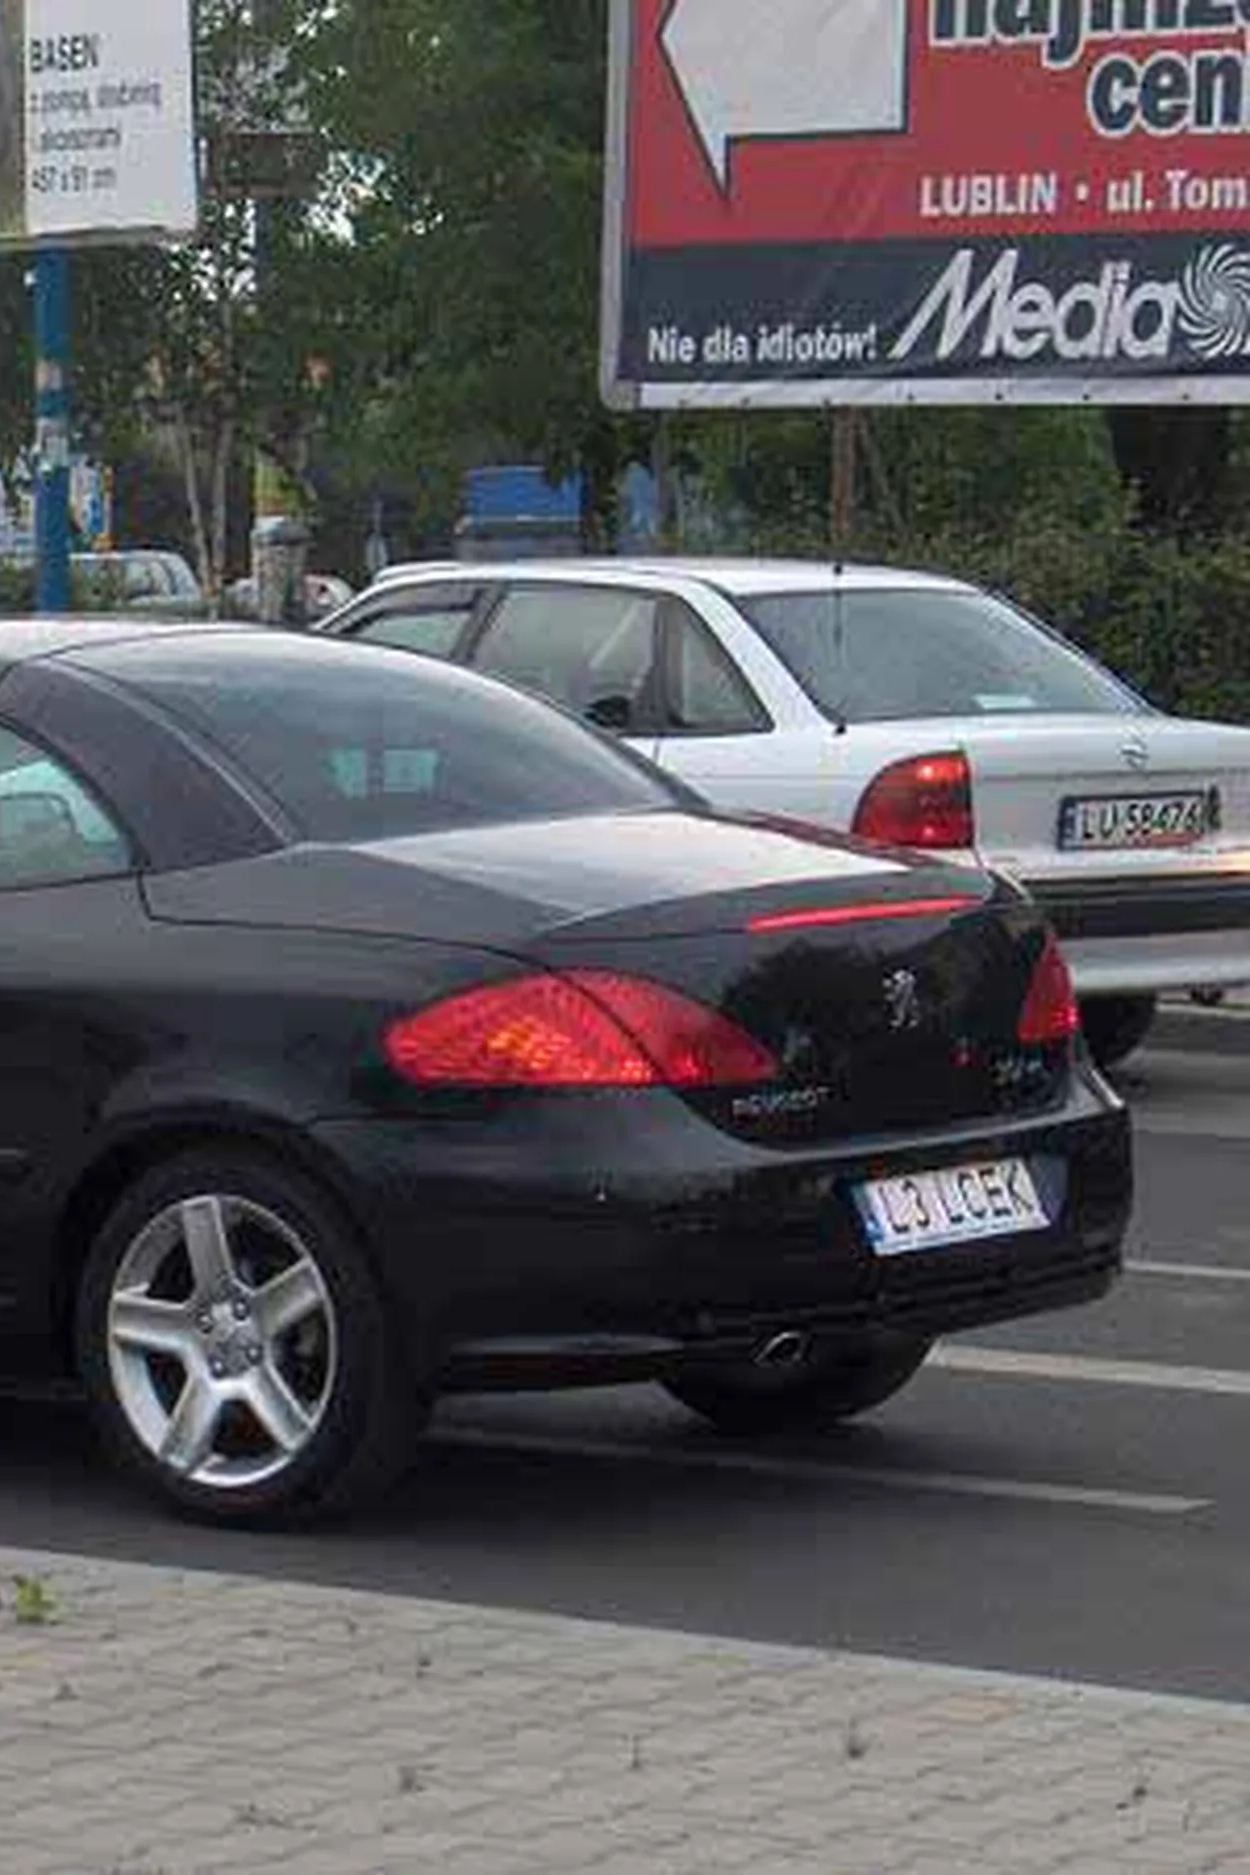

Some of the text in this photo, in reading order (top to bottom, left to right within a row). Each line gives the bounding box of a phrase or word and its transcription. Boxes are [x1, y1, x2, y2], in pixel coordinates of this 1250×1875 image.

[31, 34, 100, 73] BASEN
[919, 173, 1058, 216] LUBLIN
[1106, 171, 1155, 212] ul.
[648, 247, 1180, 363] Nie dla idiotów! Media
[1083, 804, 1118, 839] LU
